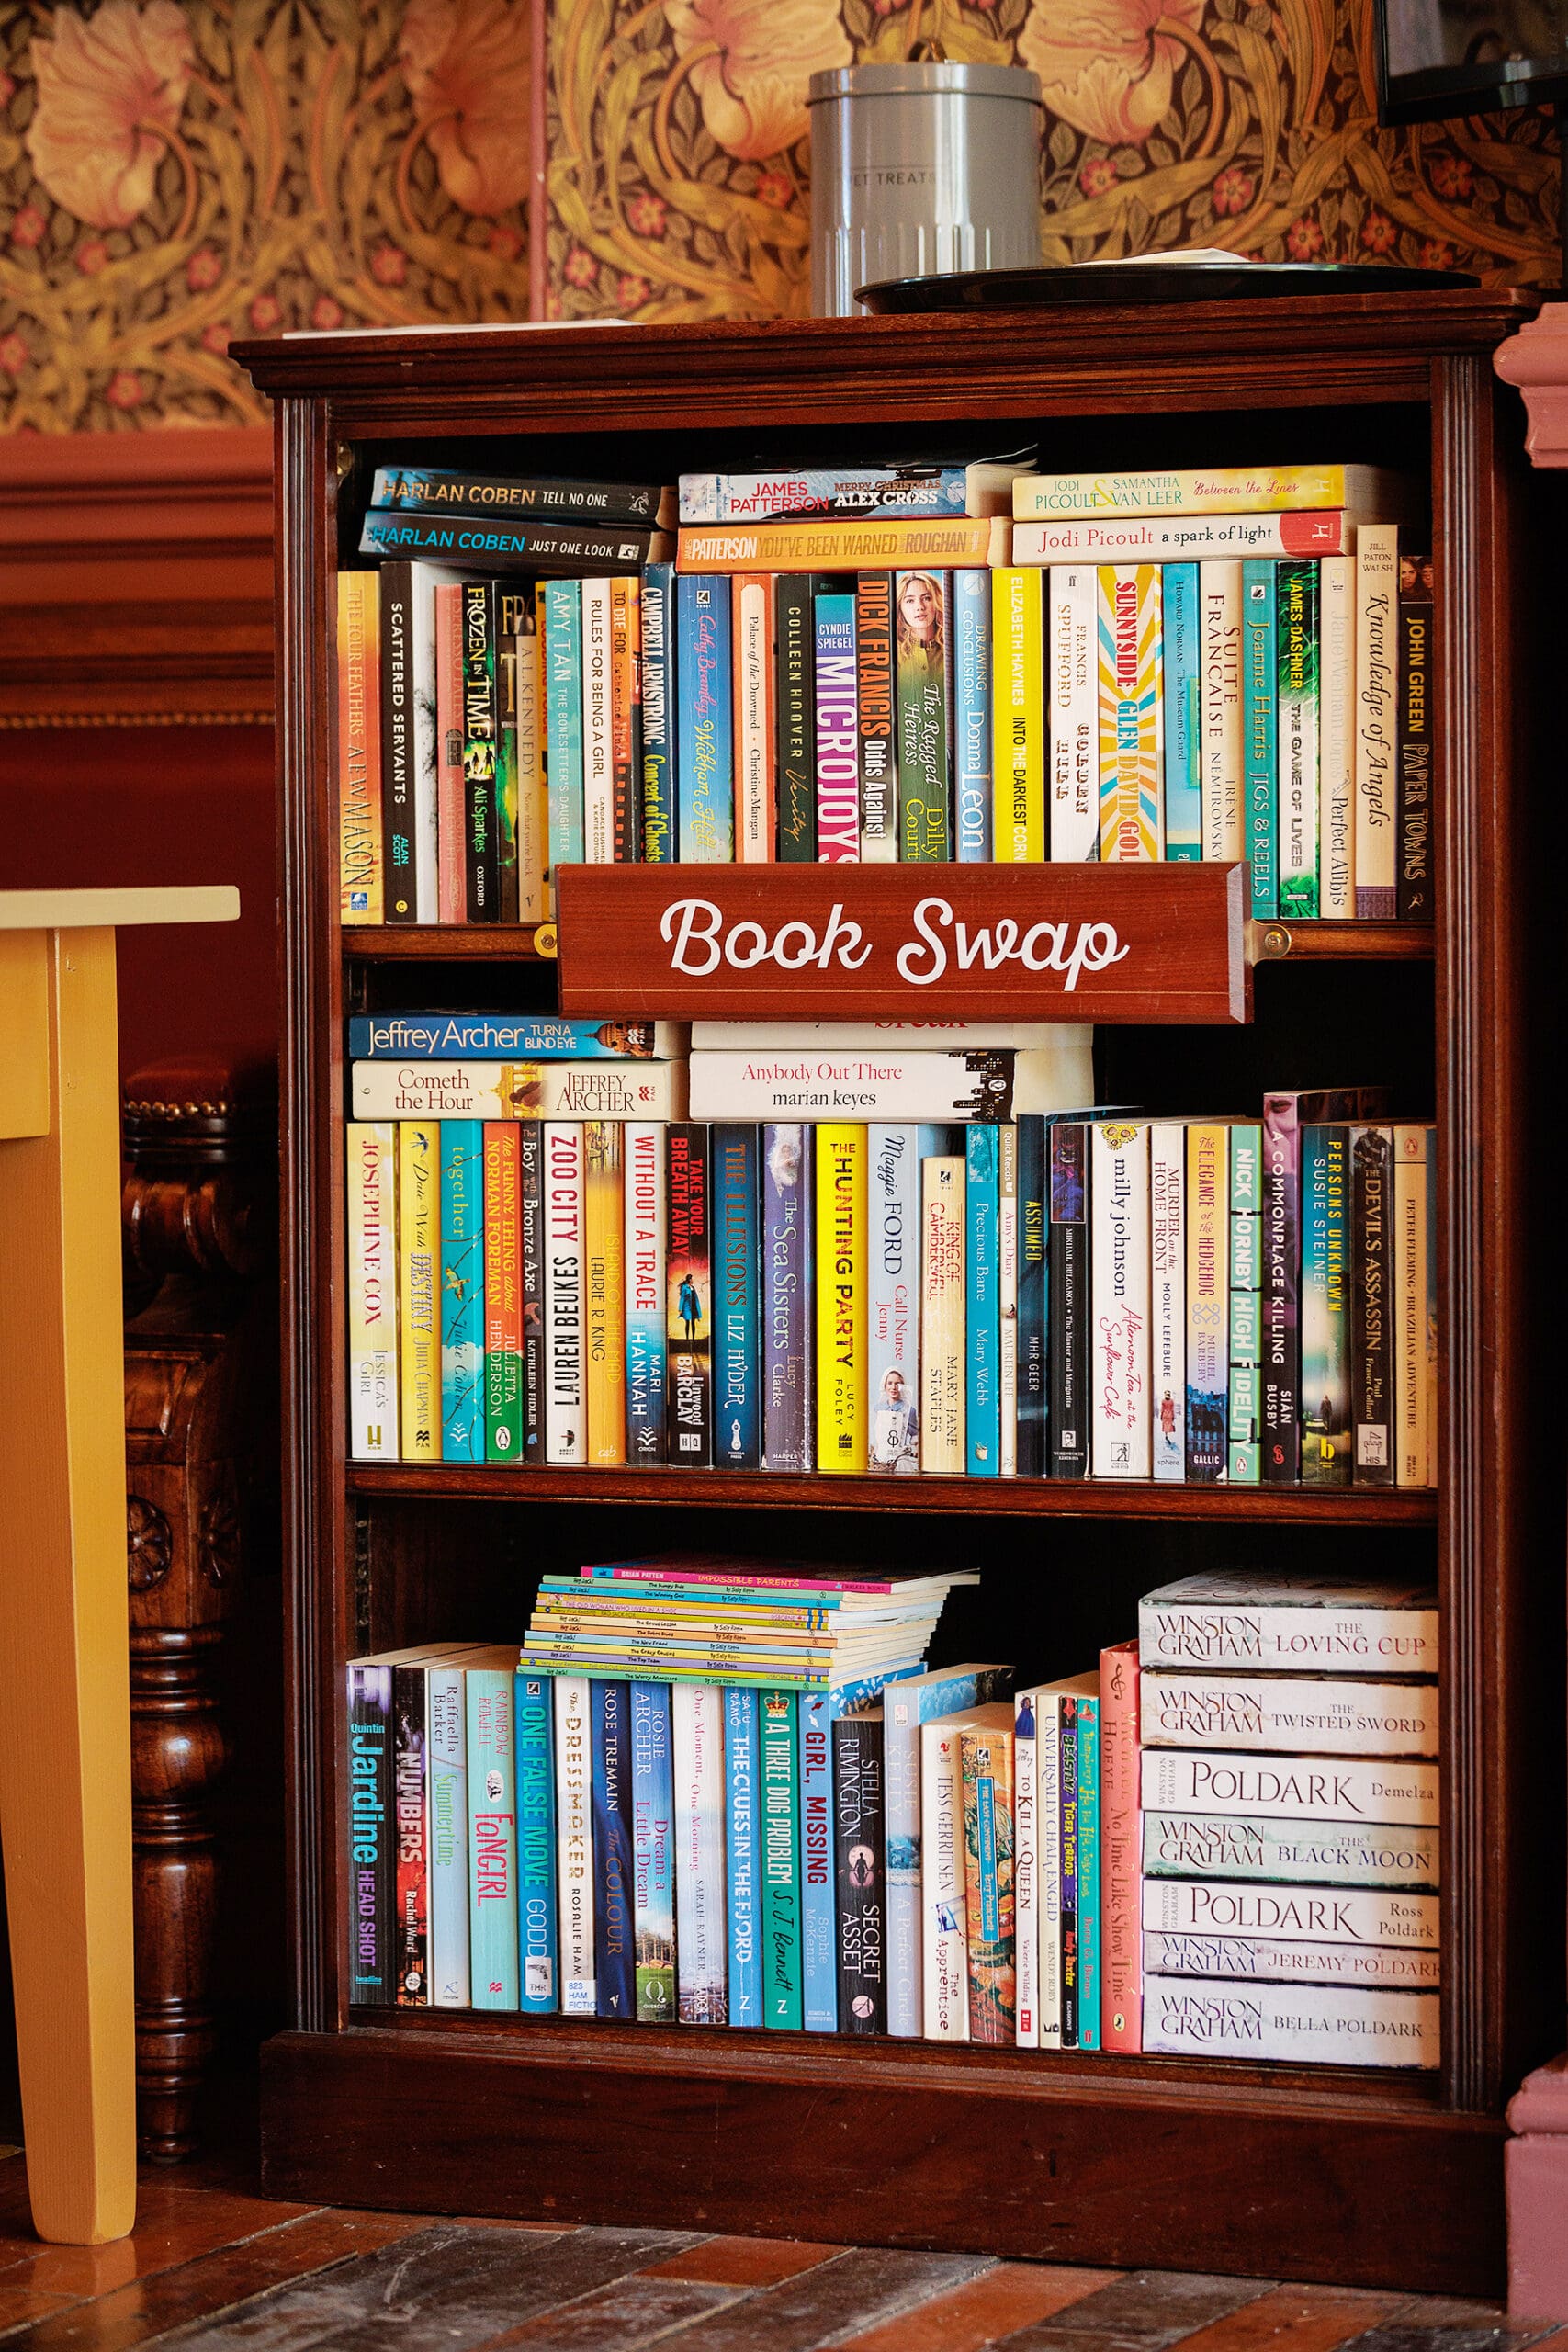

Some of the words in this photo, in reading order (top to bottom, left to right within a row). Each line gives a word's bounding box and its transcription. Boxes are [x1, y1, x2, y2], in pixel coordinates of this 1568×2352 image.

[876, 169, 932, 185] TREAT
[382, 481, 464, 503] HARLAN
[468, 484, 536, 505] COBEN
[731, 496, 829, 513] PATTERSON
[751, 482, 807, 498] JAMES
[834, 492, 881, 507] ALEX
[885, 491, 938, 506] CROSS
[1113, 477, 1180, 491] SAMANTHA
[372, 526, 455, 548] HARLAN
[458, 532, 525, 552] COBEN
[859, 581, 890, 631] DICK
[1010, 577, 1024, 649] ELIZABETH
[391, 603, 404, 706] SCATTERED
[963, 611, 974, 705] CONCLUSIONS
[975, 625, 987, 691] DRAWING
[1116, 582, 1137, 687] SUNNYSIDE
[1406, 618, 1423, 666] JOHN
[859, 639, 891, 735] FRANCIS
[1012, 653, 1025, 705] HAYNES
[1224, 627, 1240, 704] SUITE
[1117, 700, 1139, 749] GLEN
[1408, 675, 1424, 731] GREEN
[393, 714, 405, 803] SERVANTS
[864, 740, 886, 776] Odds
[1403, 744, 1428, 804] PAPER
[863, 781, 887, 838] Against
[1118, 756, 1139, 815] DAVID
[344, 802, 373, 885] MASON
[1404, 808, 1428, 879] TOWNS
[476, 866, 485, 905] OXFORD
[660, 898, 874, 978] Book
[896, 897, 1131, 992] Swap
[368, 1021, 440, 1057] Jeffrey
[441, 1019, 525, 1049] Archer
[398, 1069, 469, 1090] Cometh
[566, 1072, 626, 1095] JEFFREY
[742, 1063, 813, 1084] Anybody
[818, 1063, 850, 1080] Out
[852, 1063, 903, 1080] There
[556, 1090, 635, 1112] ARCHER
[772, 1090, 829, 1106] marian
[833, 1090, 876, 1111] keyes
[551, 1136, 578, 1179] ZOO
[671, 1138, 688, 1203] BREATH
[830, 1144, 856, 1153] THE
[877, 1135, 905, 1196] Maggie
[1235, 1148, 1254, 1198] NICK
[487, 1141, 501, 1217] NORMAN
[690, 1159, 702, 1191] TAKE
[1111, 1159, 1131, 1208] milly
[1155, 1161, 1168, 1210] HOME
[1328, 1142, 1342, 1218] PERSONS
[361, 1141, 381, 1271] JOSEPHINE
[551, 1189, 578, 1242] CITY
[672, 1206, 689, 1256] AWAY
[691, 1193, 703, 1235] YOUR
[784, 1198, 798, 1223] The
[834, 1158, 852, 1275] HUNTING
[773, 1226, 797, 1268] Sea
[884, 1202, 903, 1275] FORD
[976, 1203, 989, 1261] Precious
[1110, 1213, 1128, 1296] johnson
[1155, 1219, 1168, 1273] FRONT
[1234, 1208, 1256, 1292] HORNBY
[487, 1222, 501, 1305] FOREMAN
[976, 1266, 988, 1301] Bane
[1328, 1229, 1342, 1312] UNKNOWN
[364, 1278, 382, 1326] COX
[553, 1257, 579, 1326] BEUKES
[772, 1272, 798, 1349] Sisters
[895, 1285, 907, 1317] Call
[1162, 1283, 1172, 1320] MOLLY
[835, 1285, 854, 1368] PARTY
[875, 1301, 891, 1342] Jenny
[895, 1321, 907, 1360] Nurse
[974, 1329, 988, 1363] Mary
[1234, 1296, 1254, 1350] HIGH
[490, 1320, 502, 1416] HENDERSON
[504, 1334, 516, 1403] JULIETTA
[554, 1334, 579, 1405] LAUREN
[631, 1332, 647, 1415] HANNAH
[649, 1354, 661, 1392] MARI
[1162, 1325, 1172, 1377] LEFEBURE
[676, 1356, 694, 1424] BARCLAY
[771, 1363, 785, 1407] Clarke
[835, 1379, 844, 1425] FOLEY
[846, 1384, 855, 1421] LUCY
[976, 1369, 989, 1405] Webb
[1233, 1356, 1256, 1454] FIDELITY
[1266, 1385, 1278, 1429] BUSBY
[1193, 1455, 1221, 1464] GALLIC
[641, 1571, 664, 1579] PATTEN
[698, 1575, 753, 1585] IMPOSSIBLE
[756, 1577, 800, 1588] PARENTS
[1277, 1635, 1369, 1655] LOVING
[1378, 1636, 1426, 1655] CUP
[434, 1694, 446, 1744] Barker
[446, 1686, 459, 1752] Raffaella
[521, 1706, 547, 1750] ONE
[605, 1688, 617, 1729] ROSE
[636, 1691, 650, 1776] ARCHER
[741, 1696, 750, 1724] SATU
[1271, 1713, 1351, 1730] TWISTED
[1356, 1716, 1426, 1733] SWORD
[651, 1710, 666, 1758] ROSIE
[733, 1736, 750, 1770] THE
[522, 1757, 547, 1818] FALSE
[606, 1736, 618, 1811] TREMAIN
[840, 1738, 861, 1838] RIMINGTON
[861, 1759, 879, 1816] STELLA
[937, 1775, 953, 1805] TESS
[1190, 1761, 1365, 1814] POLDARK
[1371, 1782, 1435, 1800] Demelza
[400, 1751, 422, 1863] NUMBERS
[636, 1800, 651, 1847] Little
[733, 1778, 750, 1834] CLUES
[1064, 1802, 1076, 1832] TIGER
[525, 1825, 548, 1886] MOVE
[608, 1829, 620, 1852] The
[734, 1837, 750, 1854] IN
[939, 1811, 954, 1891] GERRITSEN
[1064, 1835, 1077, 1876] TERROR
[1278, 1846, 1349, 1865] BLACK
[1359, 1849, 1431, 1869] MOON
[637, 1852, 651, 1909] Dream
[735, 1861, 750, 1898] THE
[406, 1890, 417, 1923] Rachel
[606, 1856, 623, 1955] COLOUR
[1190, 1887, 1364, 1939] POLDARK
[1379, 1920, 1434, 1939] Poldark
[1389, 1903, 1423, 1917] Ross
[406, 1927, 417, 1952] Ward
[735, 1902, 752, 1962] FJORD
[842, 1912, 861, 1974] ASSET
[863, 1905, 880, 1982] SECRET
[936, 1939, 952, 2030] Apprentice
[950, 1973, 959, 1996] The
[1274, 2016, 1330, 2033] BELLA
[1337, 2019, 1423, 2037] POLDARK
